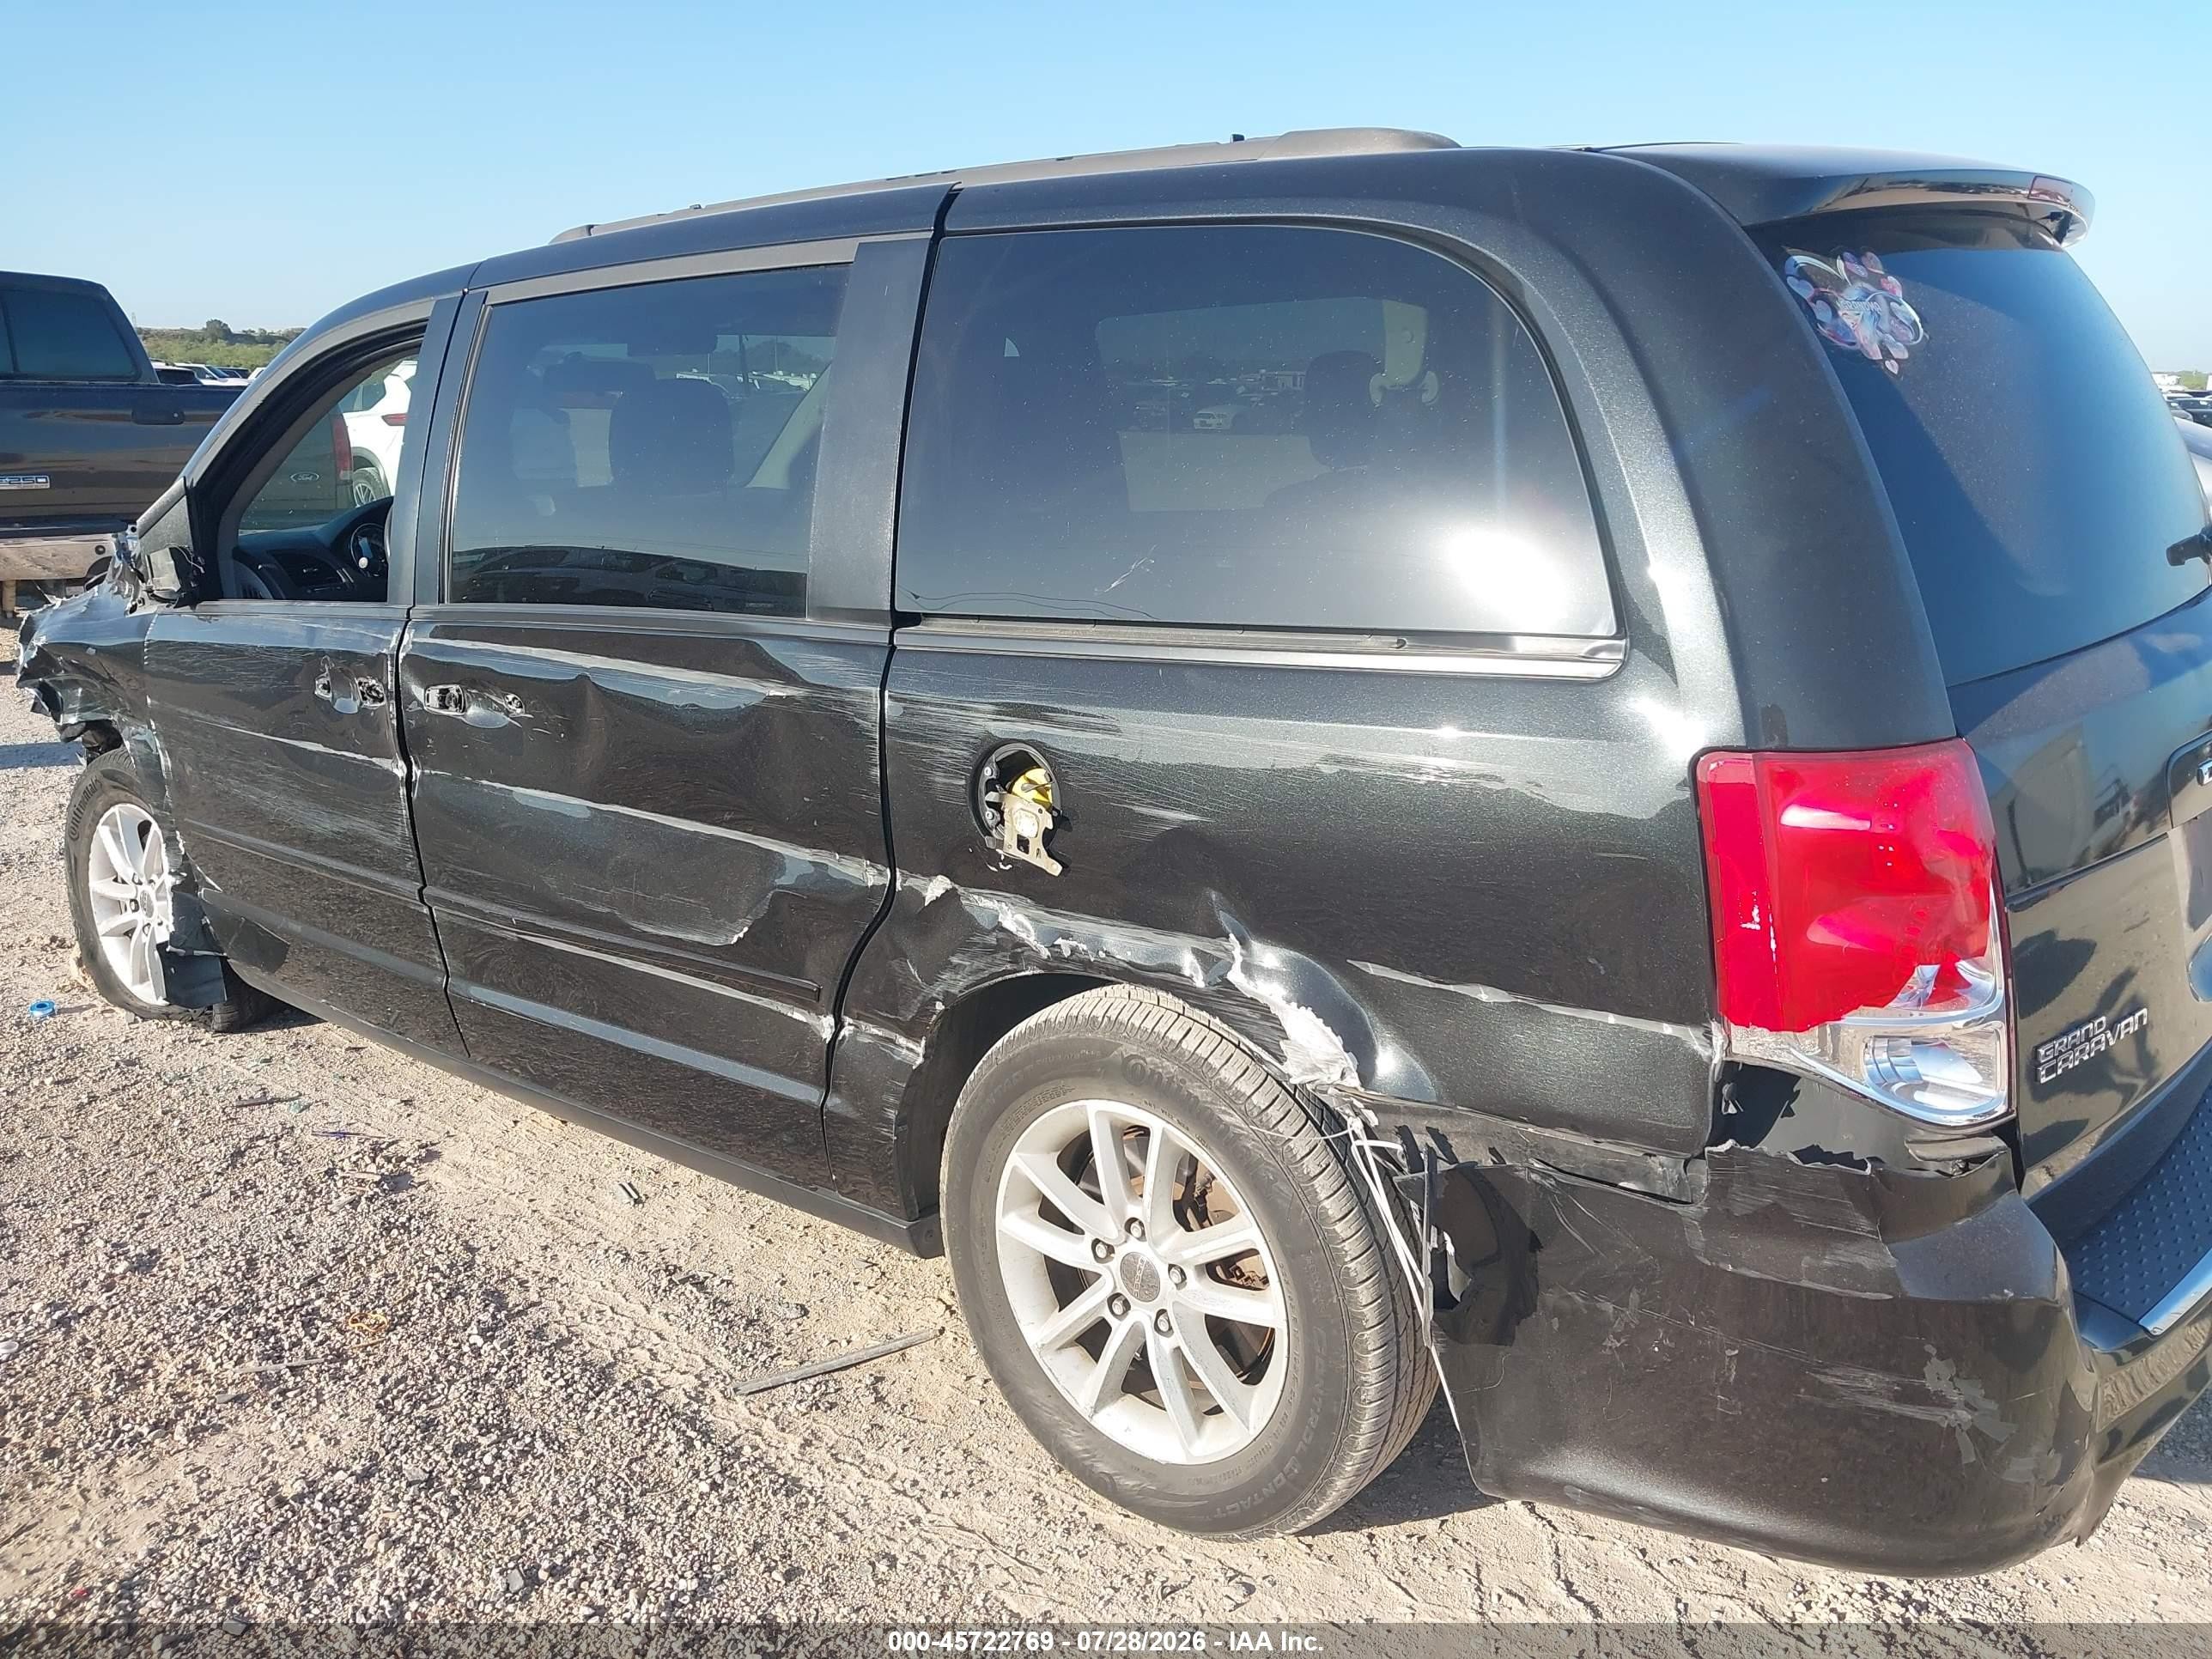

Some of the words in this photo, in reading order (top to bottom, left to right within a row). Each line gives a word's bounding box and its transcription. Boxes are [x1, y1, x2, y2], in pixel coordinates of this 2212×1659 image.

[69, 777, 98, 842] Continental
[2035, 1016, 2106, 1063] GRAND
[2035, 1007, 2148, 1084] CARAVAN
